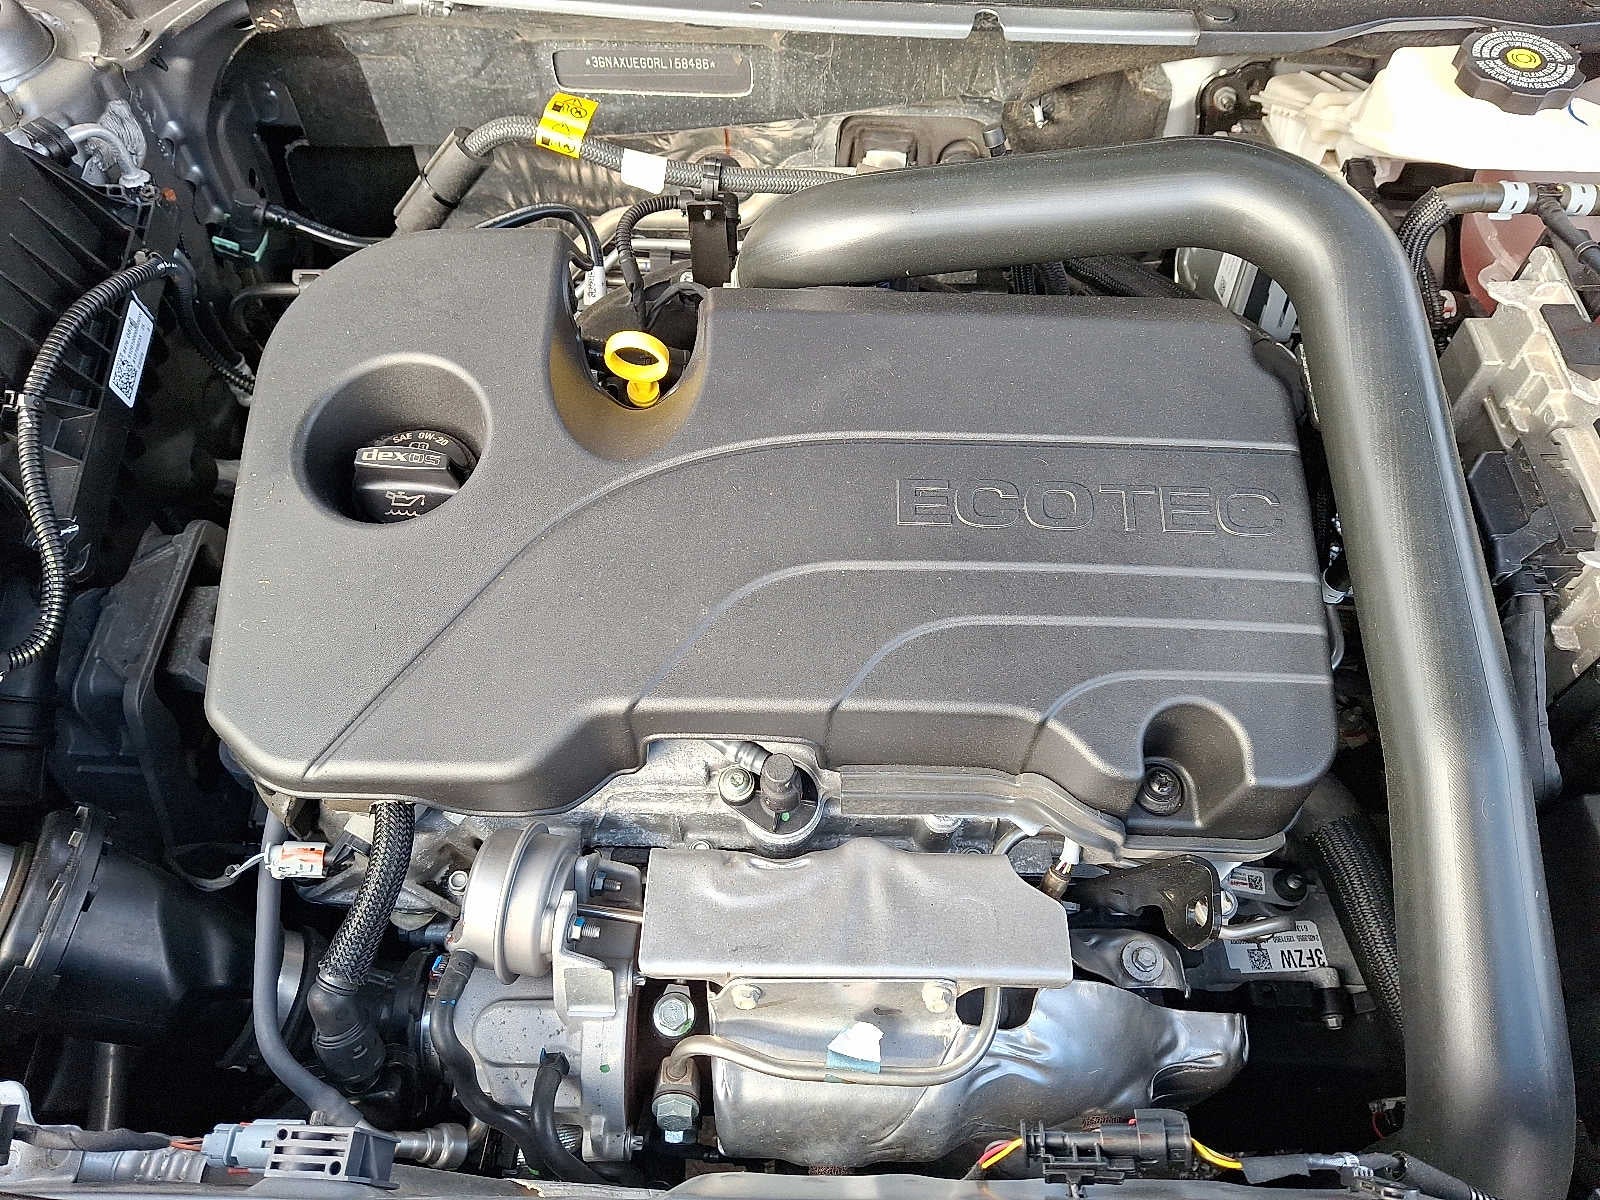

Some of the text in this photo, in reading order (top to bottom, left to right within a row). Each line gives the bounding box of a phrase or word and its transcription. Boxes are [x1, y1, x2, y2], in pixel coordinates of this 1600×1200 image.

[393, 432, 413, 444] SAE
[417, 431, 449, 446] 0W-20
[361, 449, 441, 466] dexos
[896, 478, 1283, 537] ECOTEC
[1280, 948, 1327, 969] 3FZW
